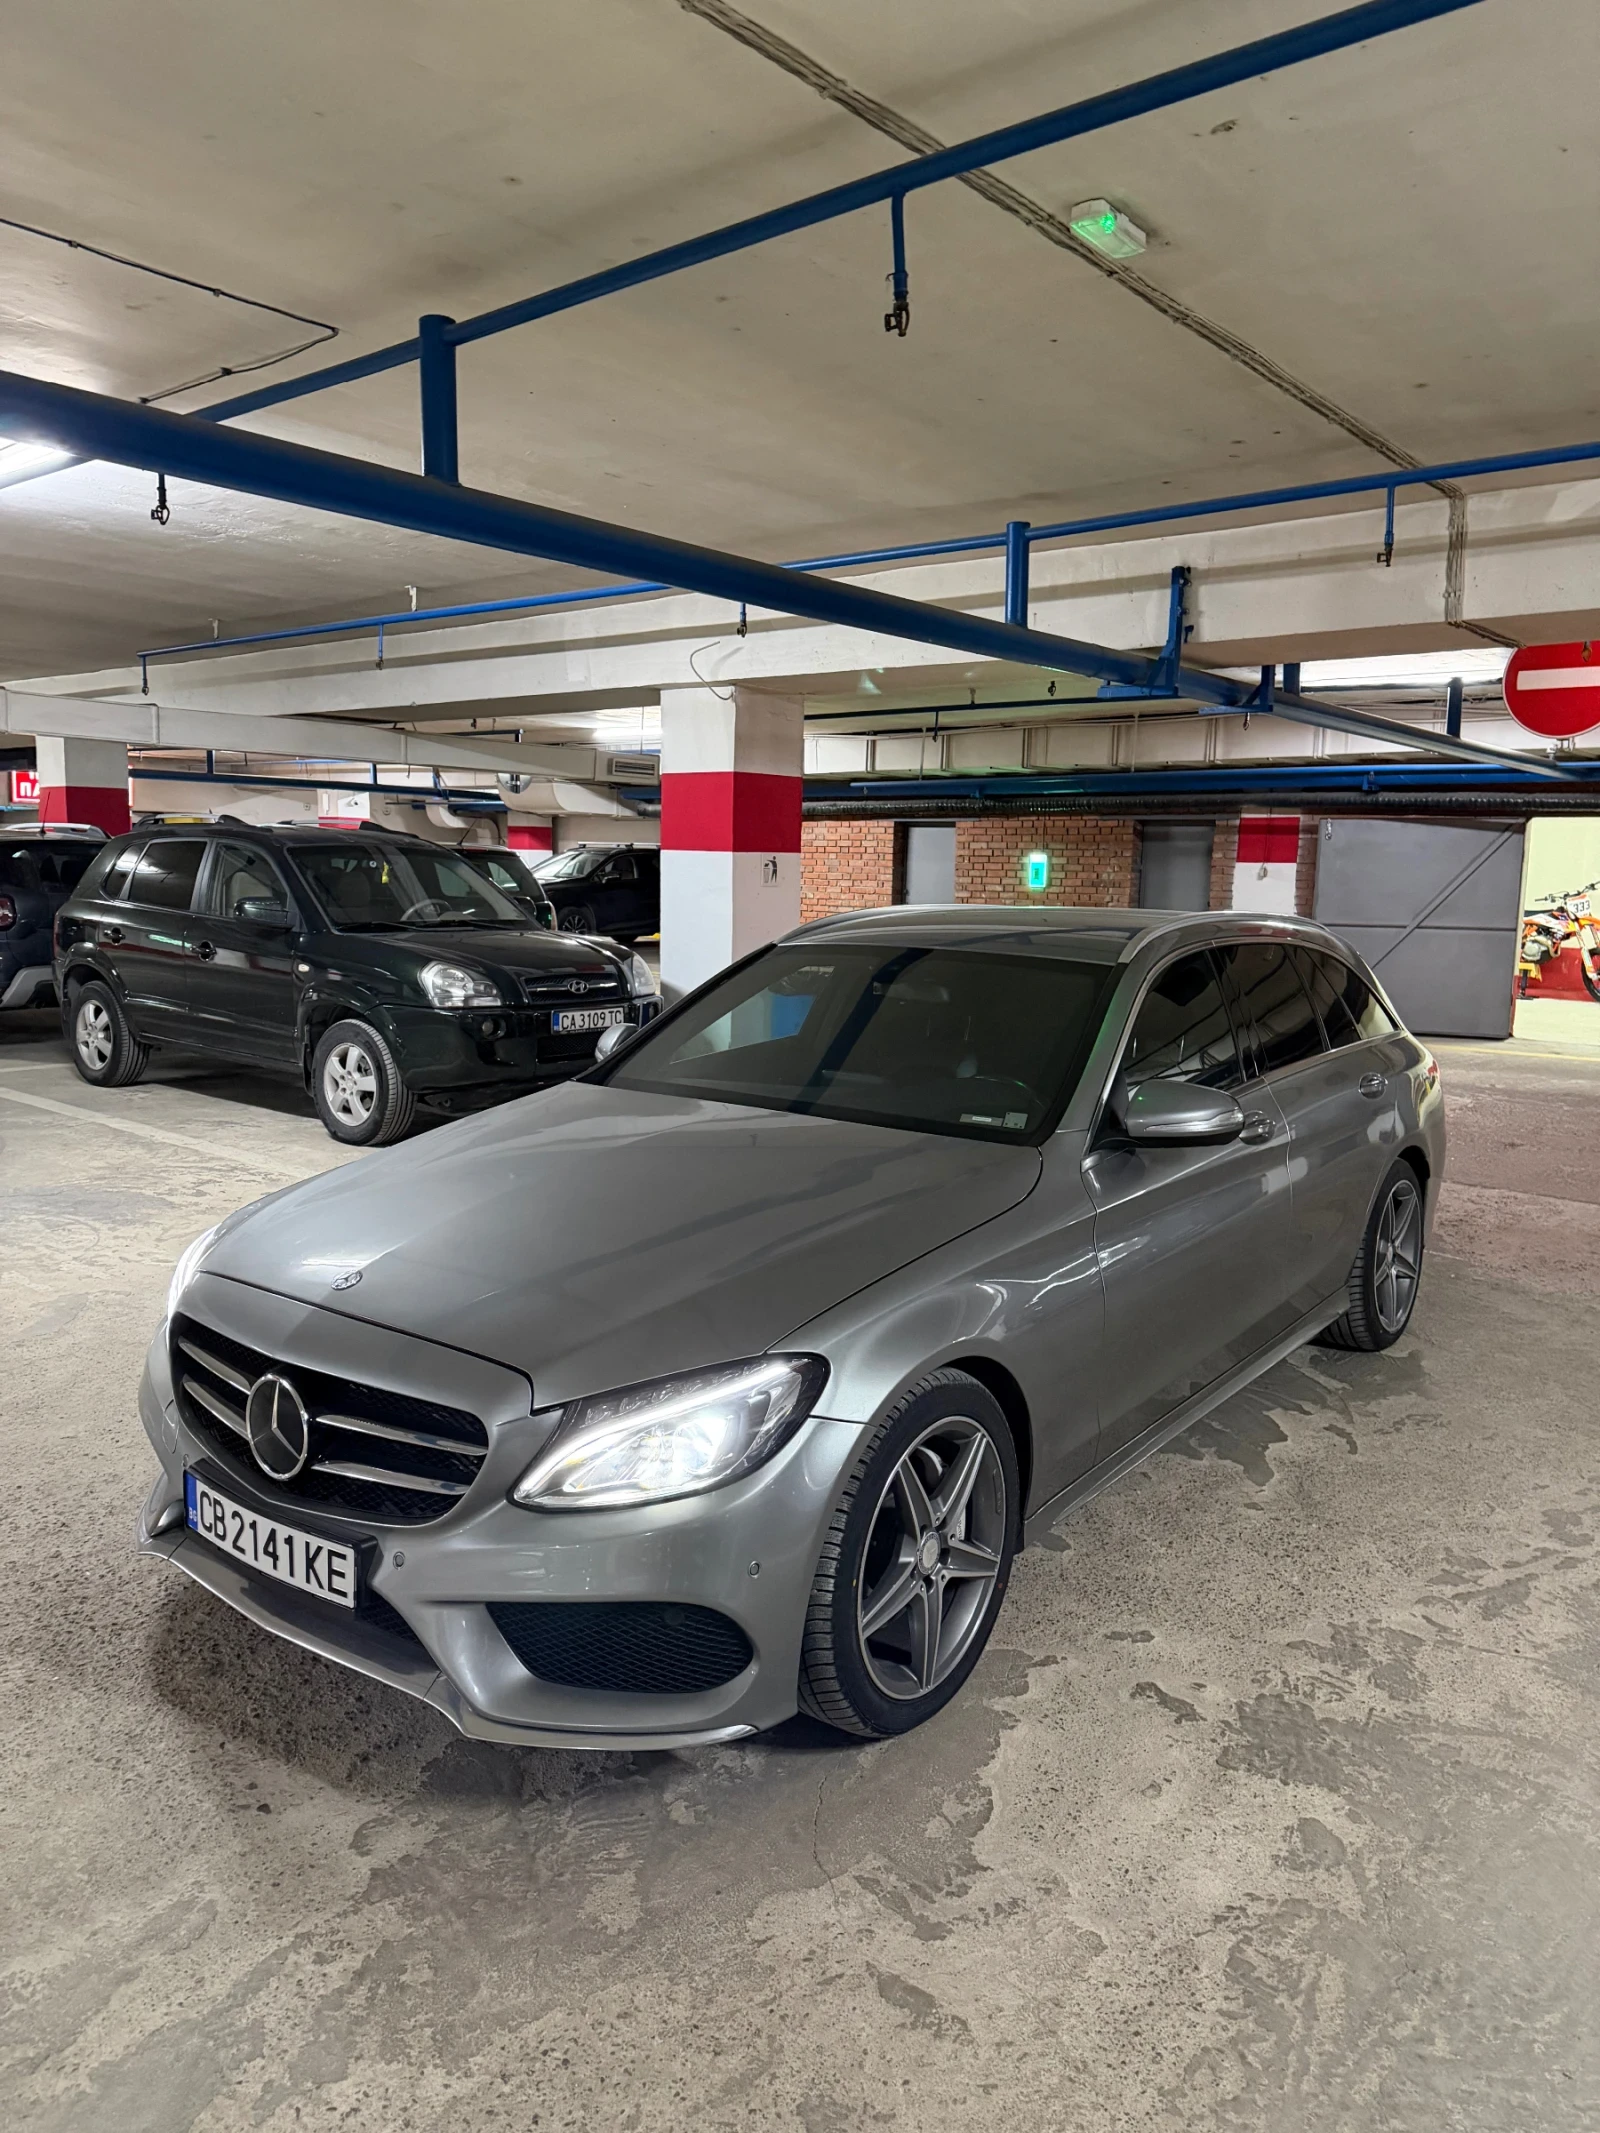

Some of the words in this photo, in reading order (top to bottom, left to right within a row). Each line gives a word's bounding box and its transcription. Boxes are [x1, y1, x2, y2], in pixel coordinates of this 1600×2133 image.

[561, 1015, 577, 1029] CA
[579, 1012, 606, 1029] 3109
[608, 1010, 622, 1025] TC
[188, 1507, 197, 1522] BG
[200, 1490, 227, 1542] CB
[231, 1511, 295, 1578] 2141
[305, 1540, 348, 1599] KE
